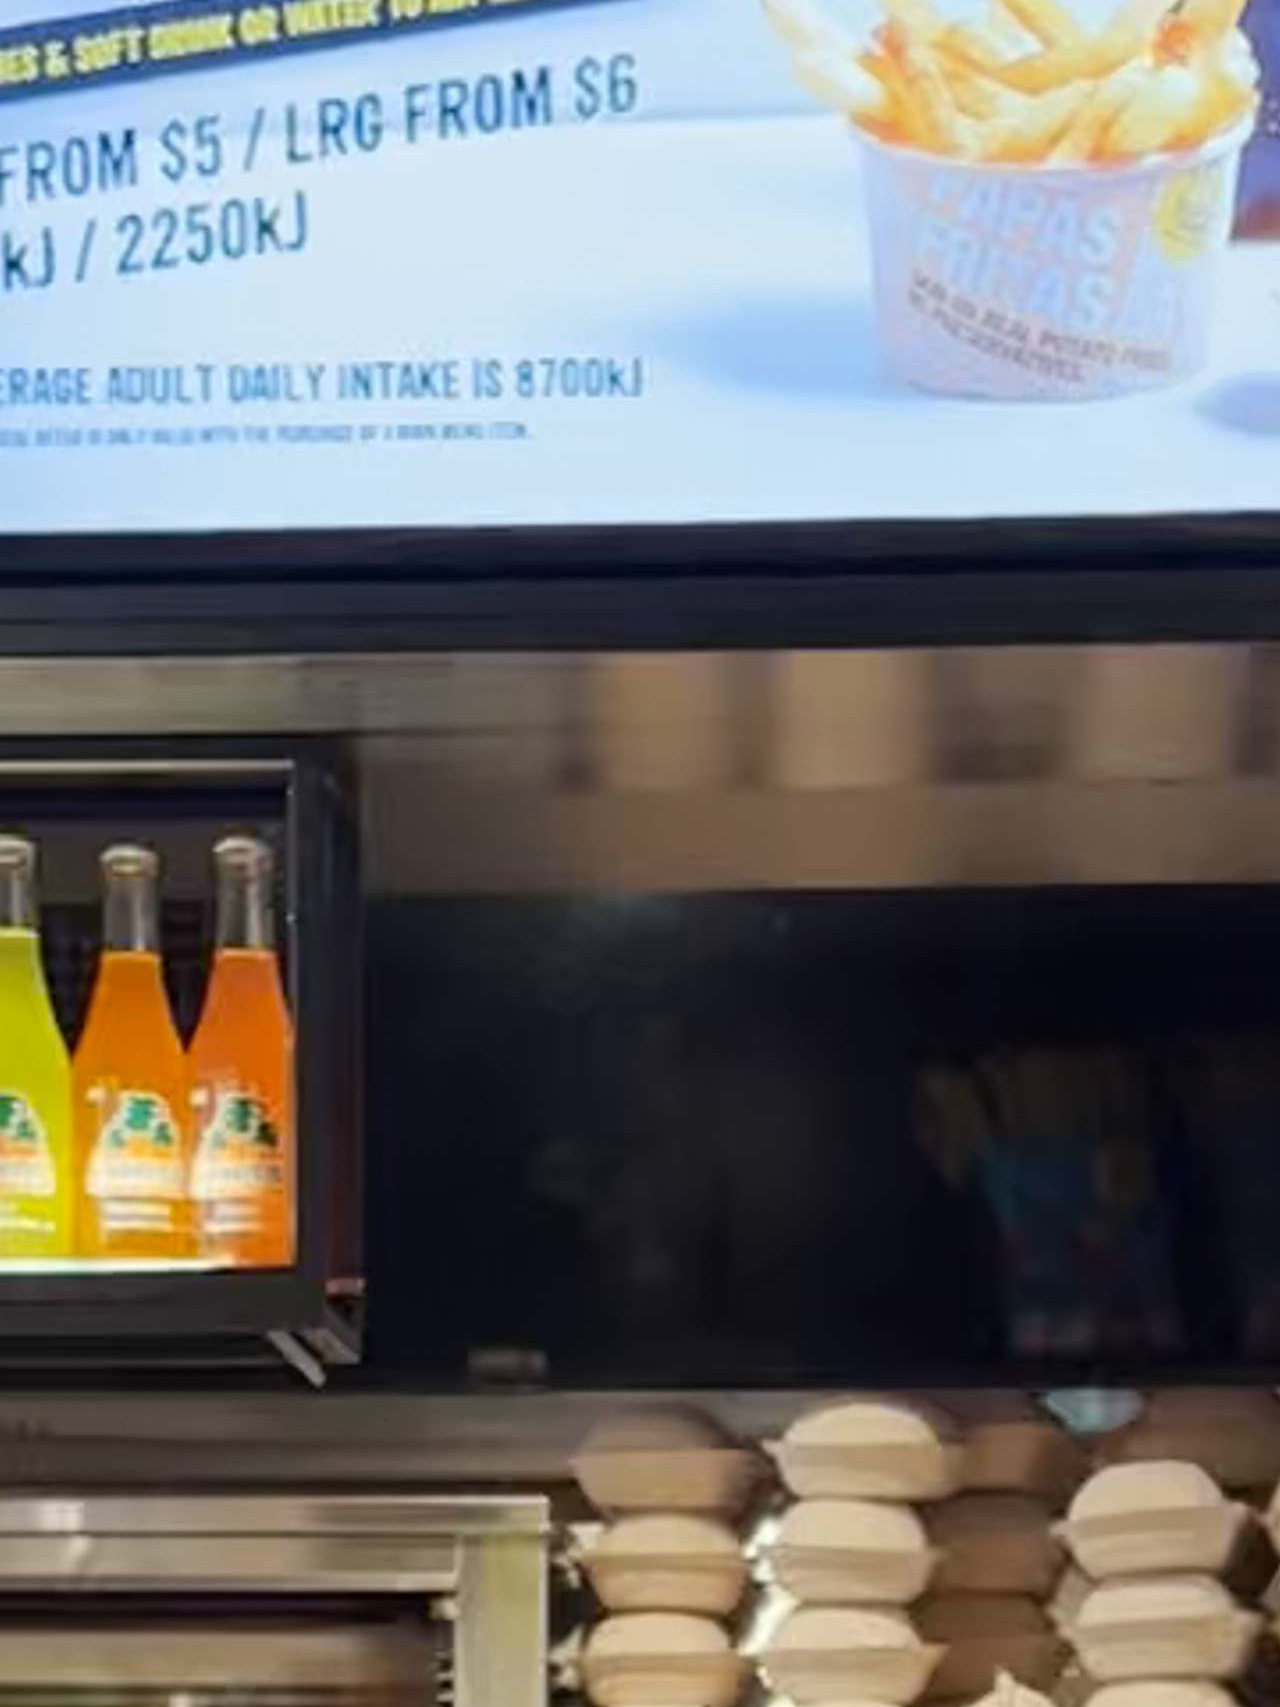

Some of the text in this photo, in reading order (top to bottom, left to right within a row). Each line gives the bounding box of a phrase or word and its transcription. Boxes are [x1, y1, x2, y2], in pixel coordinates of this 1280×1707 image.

[44, 41, 69, 78] &
[73, 28, 145, 72] SOFT
[237, 6, 280, 43] OR
[159, 114, 222, 185] $5
[244, 108, 265, 171] /
[286, 90, 383, 162] LRG
[404, 65, 552, 142] FROM
[574, 52, 638, 121] $6
[75, 221, 97, 283] /
[116, 191, 309, 277] 2250kJ
[107, 364, 214, 405] ADULT
[228, 362, 326, 403] DAILY
[337, 360, 460, 400] INTAKE
[473, 359, 504, 399] IS
[515, 357, 643, 399] 8700kJ
